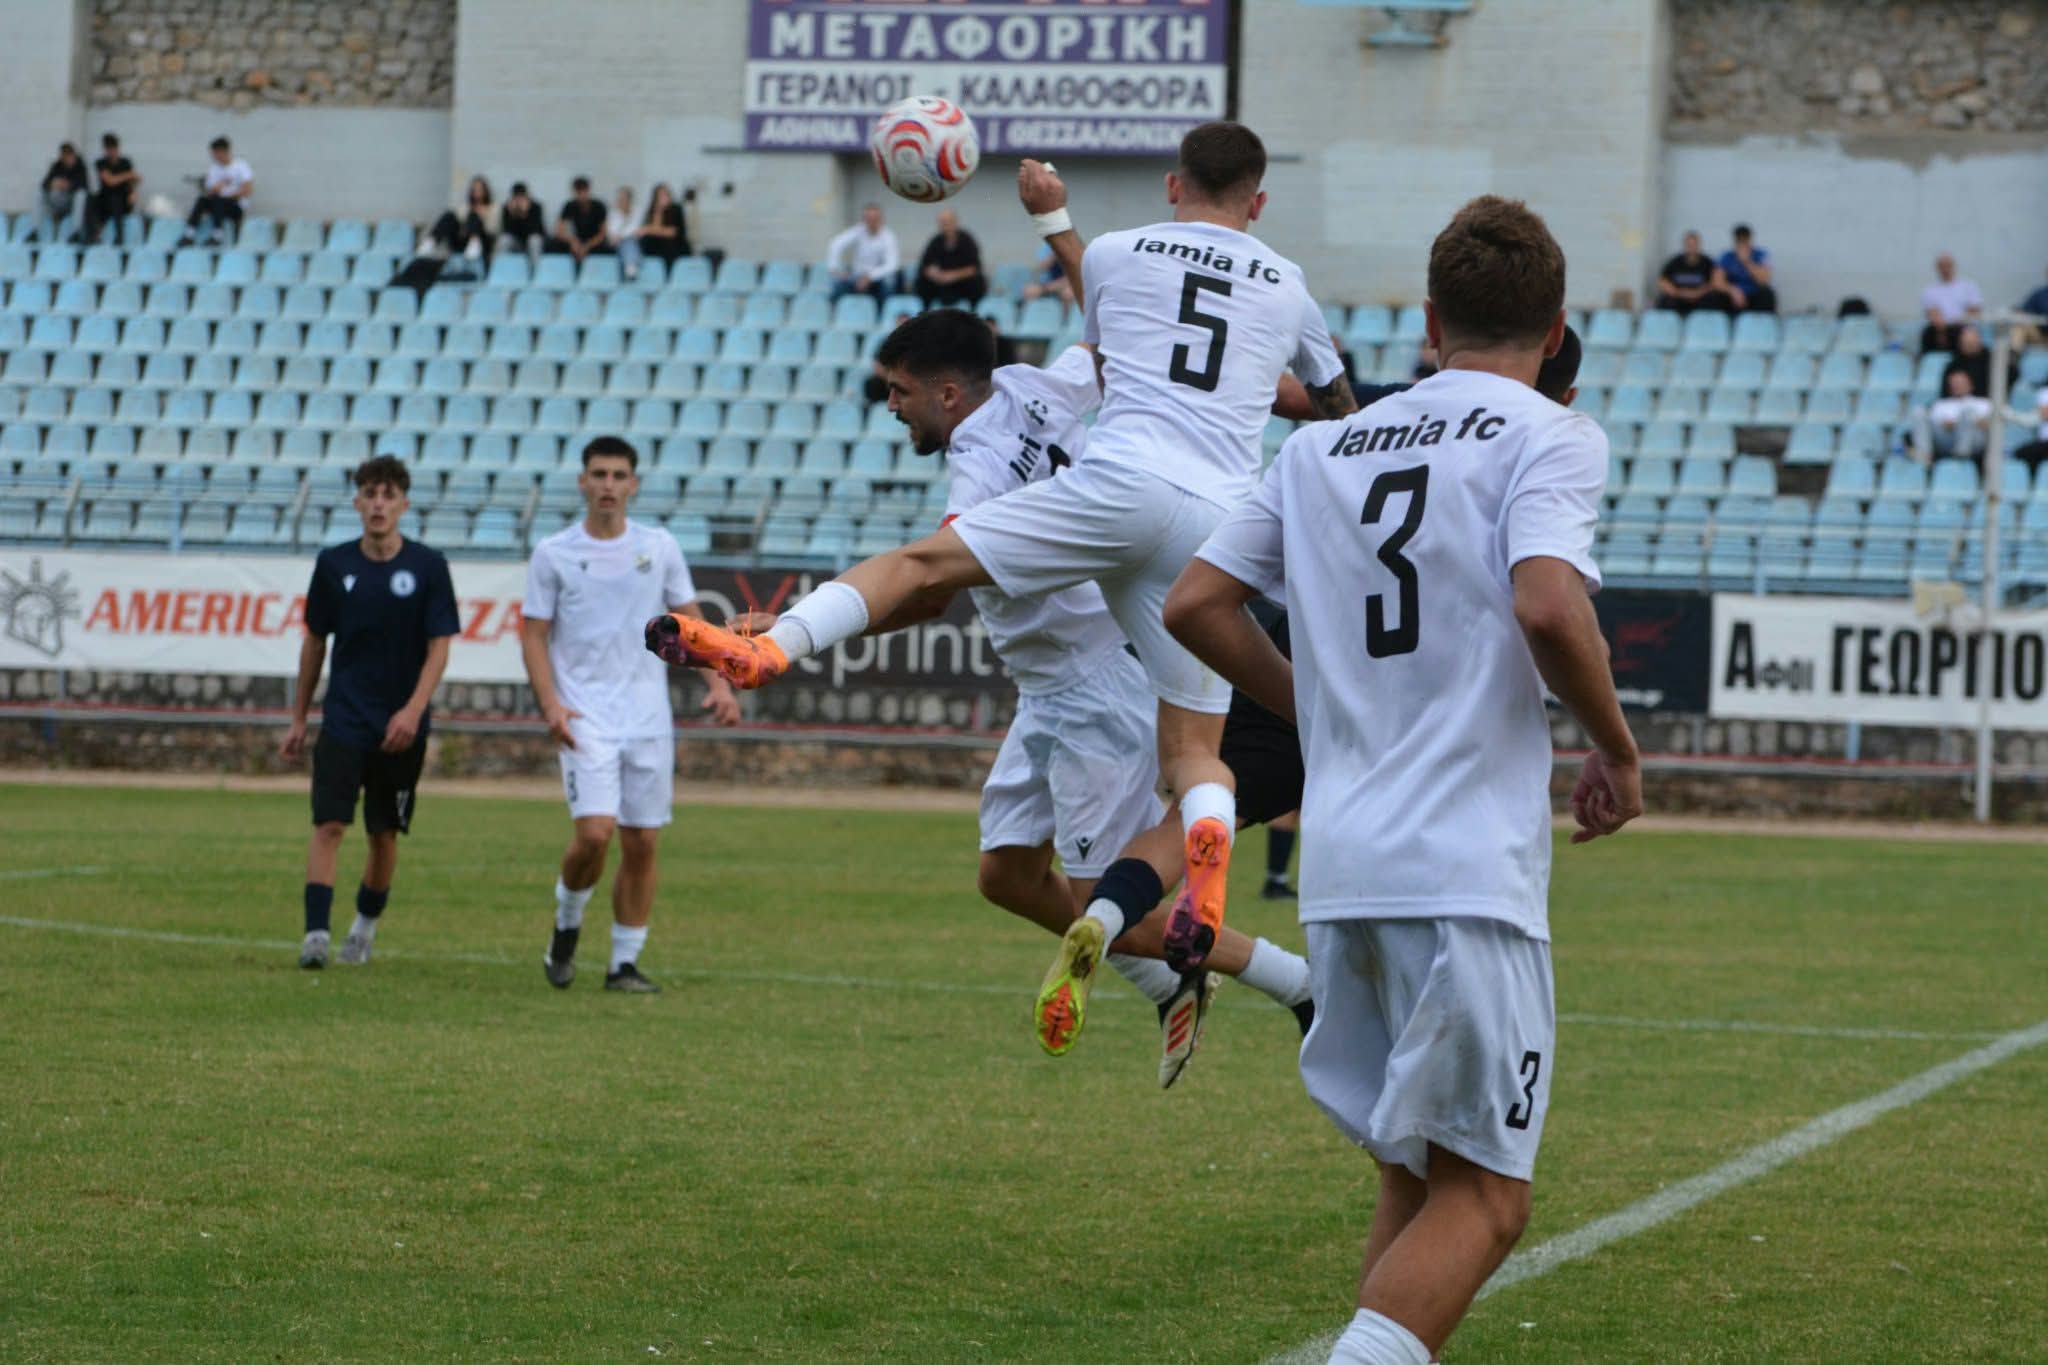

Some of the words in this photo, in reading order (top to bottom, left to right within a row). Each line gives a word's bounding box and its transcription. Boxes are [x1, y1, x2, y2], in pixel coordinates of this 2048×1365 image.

[769, 12, 1208, 61] ΜΕΤΑΦΟΡΙΚΗ
[959, 75, 1211, 109] ΚΑΛΑΘΟΦΟΡΑ
[1133, 238, 1233, 273] lamia
[1247, 259, 1281, 284] fc
[1169, 271, 1232, 392] 5
[1328, 414, 1448, 457] lamia
[1454, 407, 1507, 441] fc
[1360, 463, 1430, 659] 3
[1504, 1050, 1541, 1131] 3
